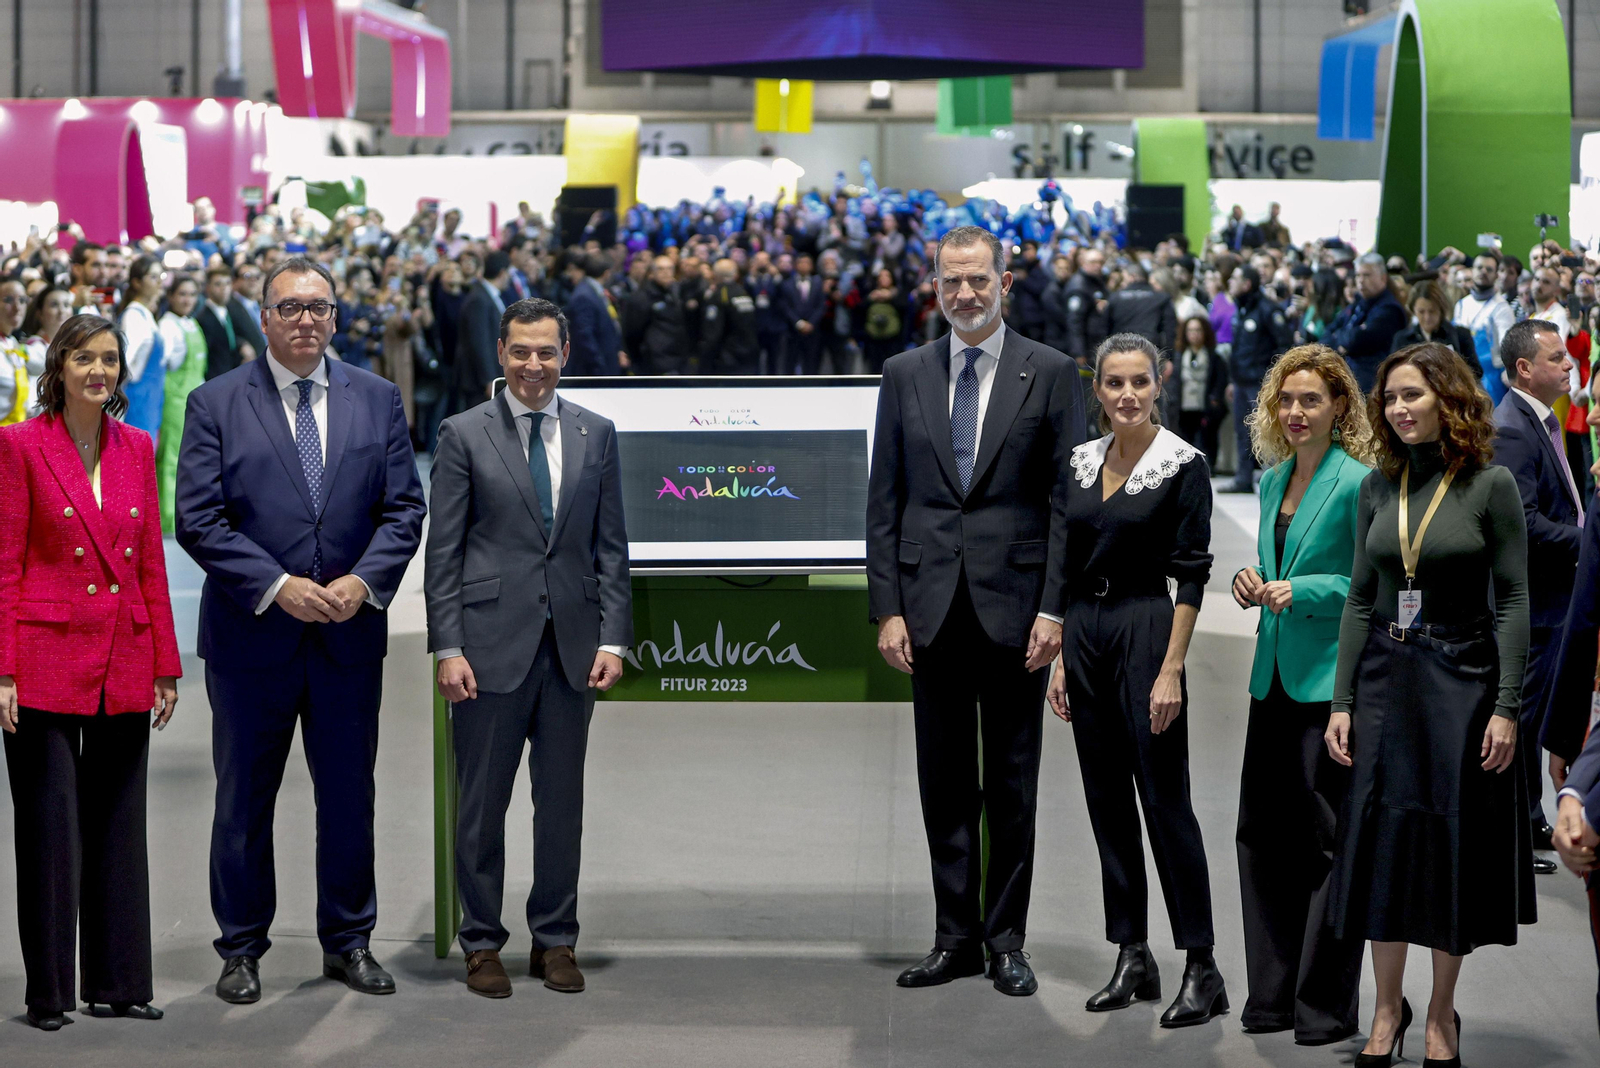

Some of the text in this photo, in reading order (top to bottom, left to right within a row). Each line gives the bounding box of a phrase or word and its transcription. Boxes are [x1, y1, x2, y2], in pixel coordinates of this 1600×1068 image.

[727, 465, 775, 473] COLOR
[655, 476, 801, 500] Andalucía
[660, 678, 748, 692] FITUR 2023
